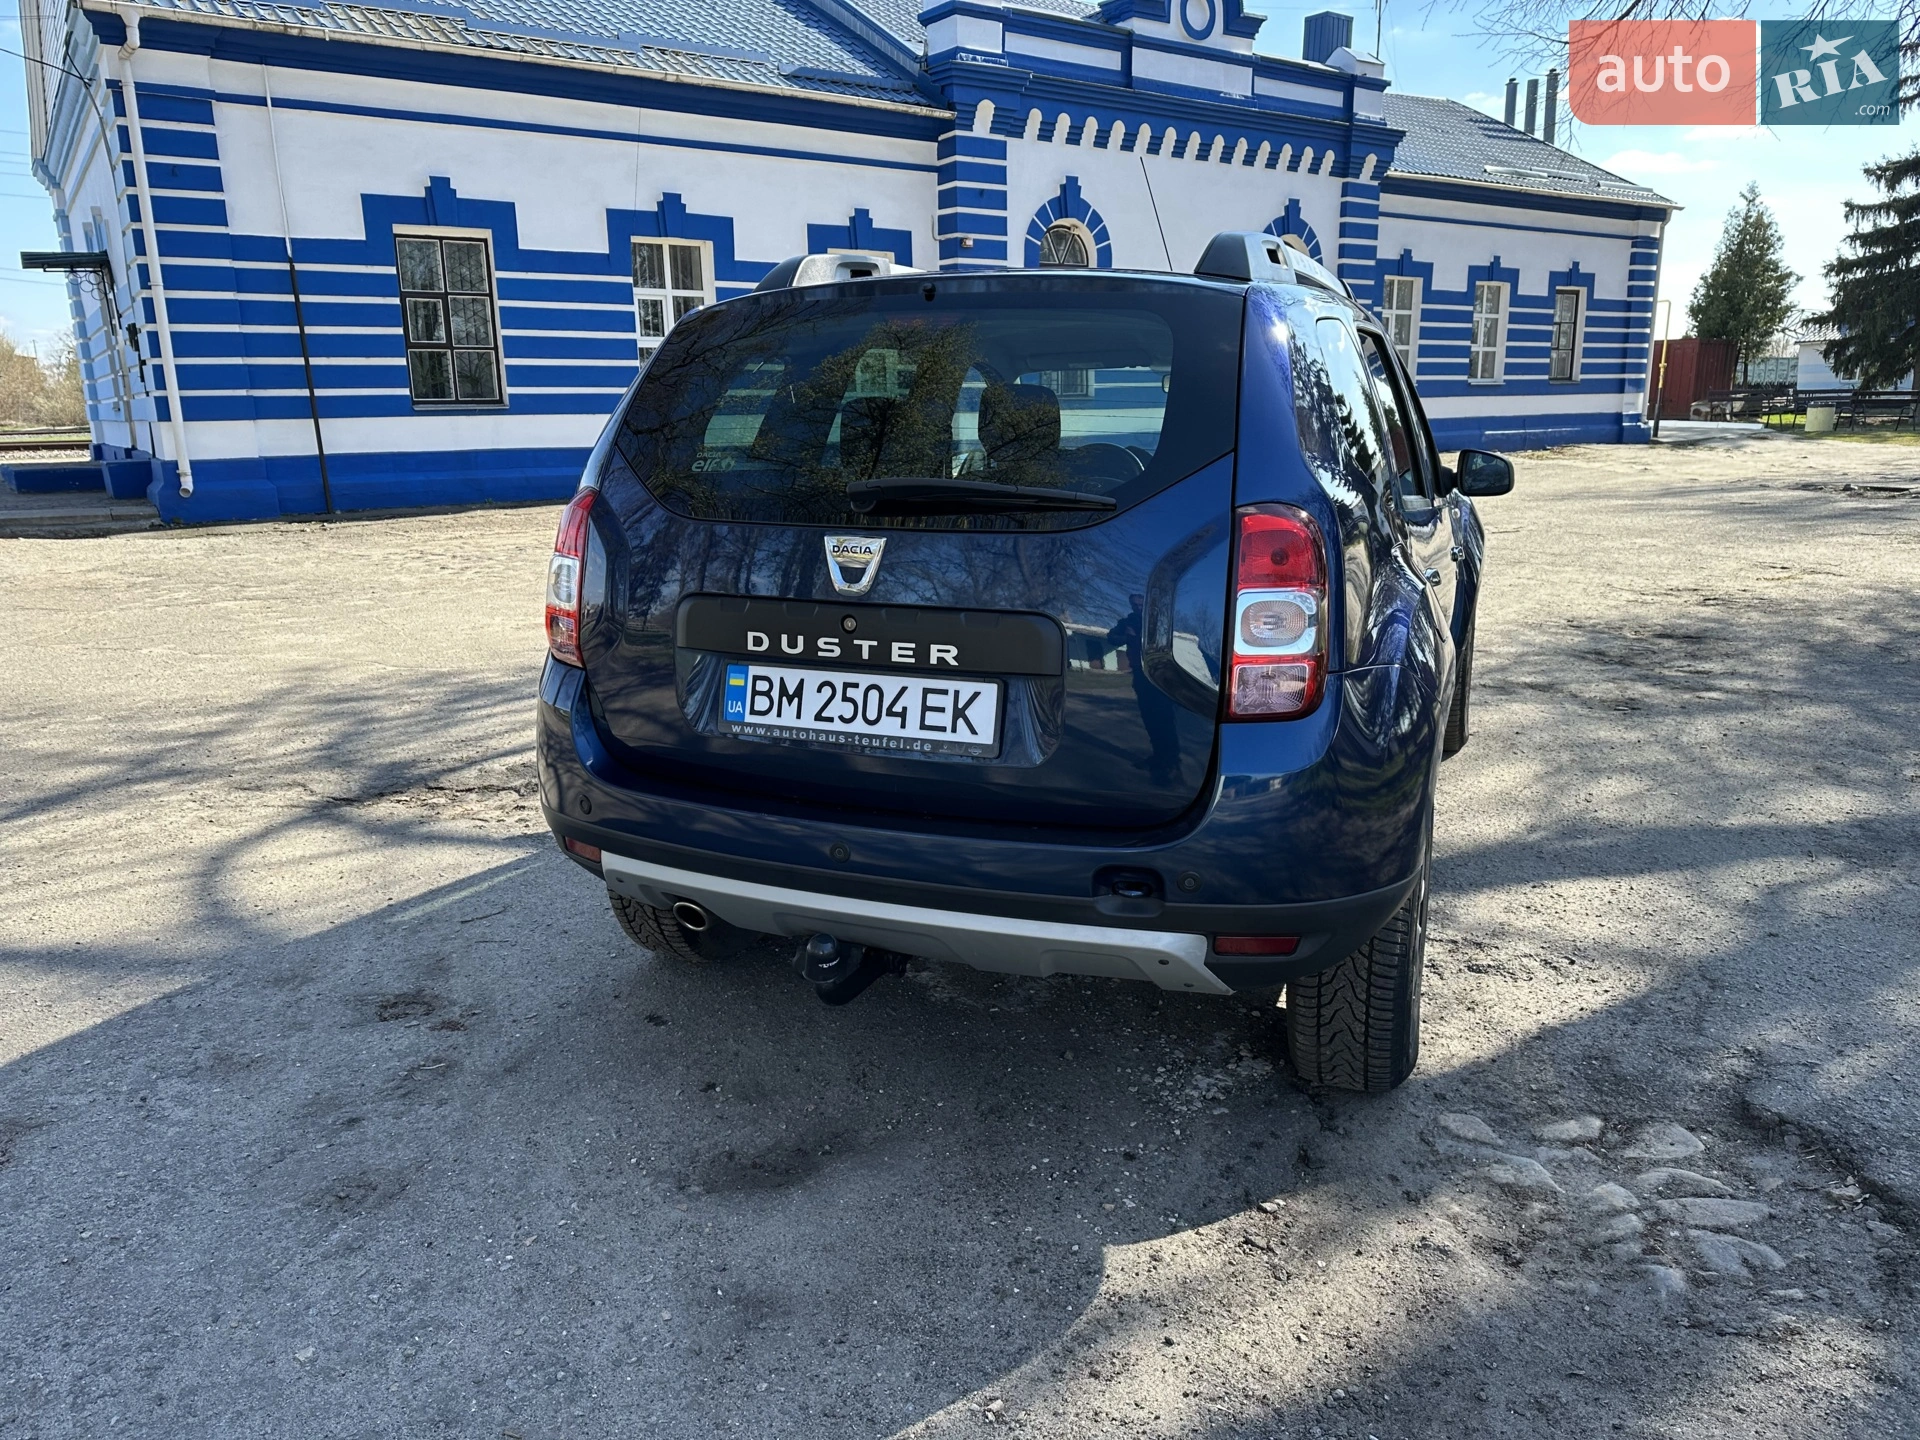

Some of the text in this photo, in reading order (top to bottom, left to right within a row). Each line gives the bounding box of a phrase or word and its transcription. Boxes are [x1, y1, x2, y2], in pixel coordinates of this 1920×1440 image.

[691, 458, 720, 472] elf
[832, 545, 873, 555] DACIA
[747, 631, 959, 666] DUSTER
[728, 700, 743, 714] UA
[749, 674, 982, 735] BM 2504 EK
[731, 723, 932, 752] www.autohaus-teufel.de
